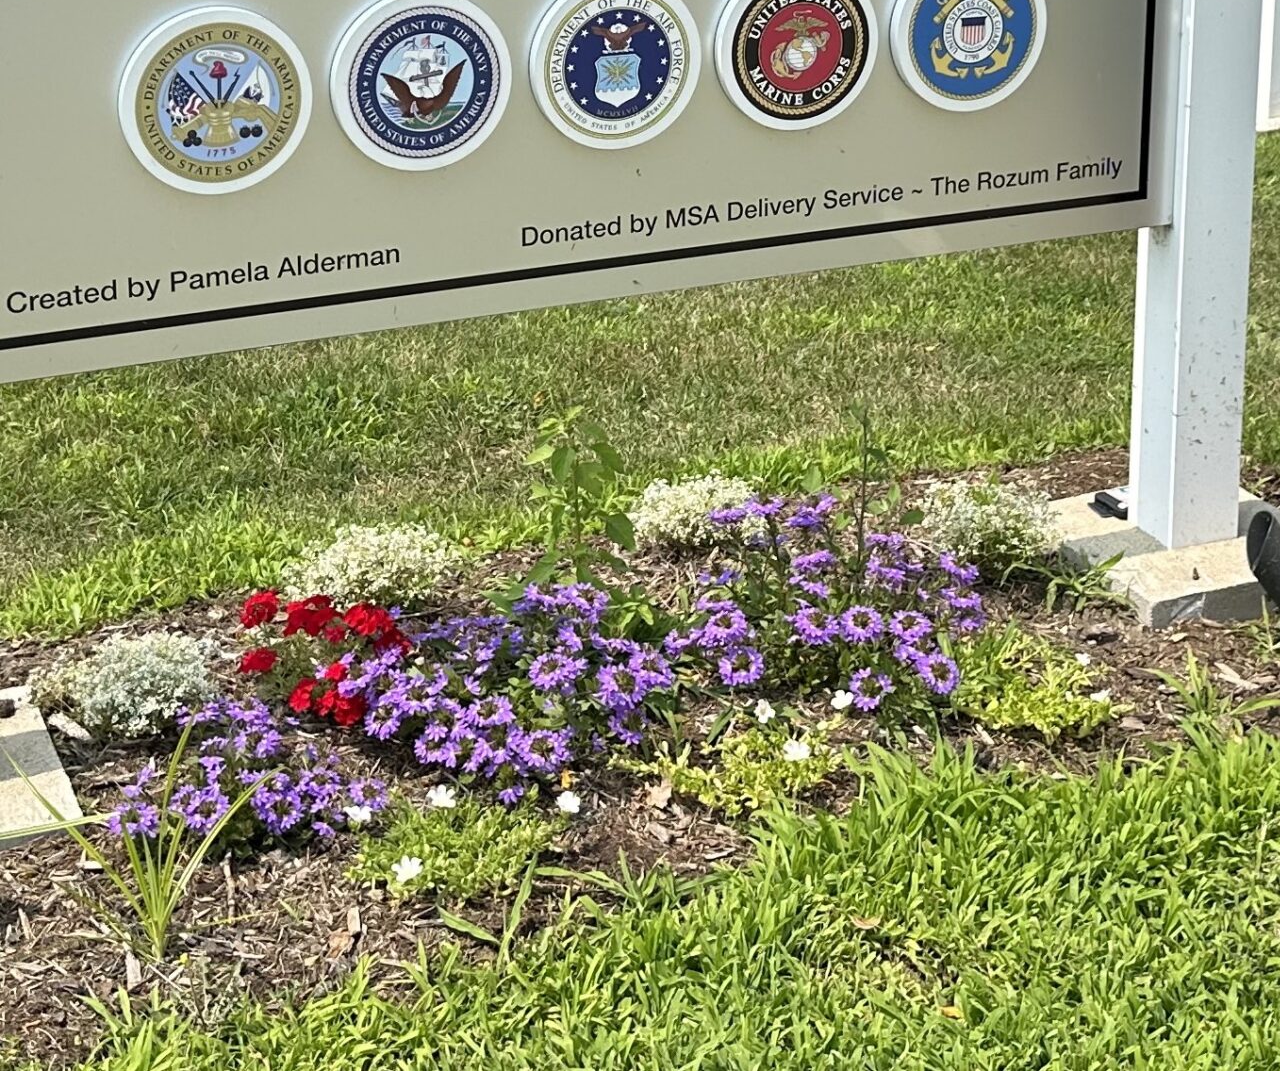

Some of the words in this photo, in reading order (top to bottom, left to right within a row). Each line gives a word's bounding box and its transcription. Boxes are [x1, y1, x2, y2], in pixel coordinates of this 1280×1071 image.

[976, 0, 999, 19] COAST
[143, 30, 214, 100] DEPARTMENT
[222, 29, 241, 41] OF
[246, 34, 272, 55] THE
[271, 56, 295, 92] ARMY
[363, 20, 428, 77] DEPARTMENT
[431, 20, 448, 31] OF
[452, 25, 473, 45] THE
[469, 43, 488, 73] NAVY
[551, 6, 591, 94] DEPARTMENT
[655, 12, 676, 34] AIR
[670, 39, 685, 84] FORCE
[749, 65, 804, 106] MARINE
[812, 57, 852, 100] CORPS
[144, 114, 175, 161] UNITED
[177, 159, 233, 176] STATES
[237, 157, 255, 172] OF
[257, 102, 294, 162] AMERICA
[360, 90, 386, 132] UNITED
[383, 128, 427, 147] STATES
[429, 132, 446, 145] OF
[450, 91, 487, 137] AMERICA
[563, 103, 587, 125] UNITED
[591, 119, 618, 131] STATES
[625, 120, 636, 129] OF
[640, 95, 669, 123] AMERICA
[206, 146, 236, 157] 1775
[521, 215, 621, 247] Donated
[630, 213, 658, 236] by
[666, 204, 719, 229] MSA
[727, 196, 816, 221] Delivery
[823, 184, 904, 210] Service
[931, 176, 970, 196] The
[977, 167, 1049, 191] Rozum
[1056, 156, 1123, 181] Family
[6, 279, 117, 314] Created
[127, 276, 160, 301] by
[170, 261, 269, 292] Pamela
[277, 246, 400, 278] Alderman
